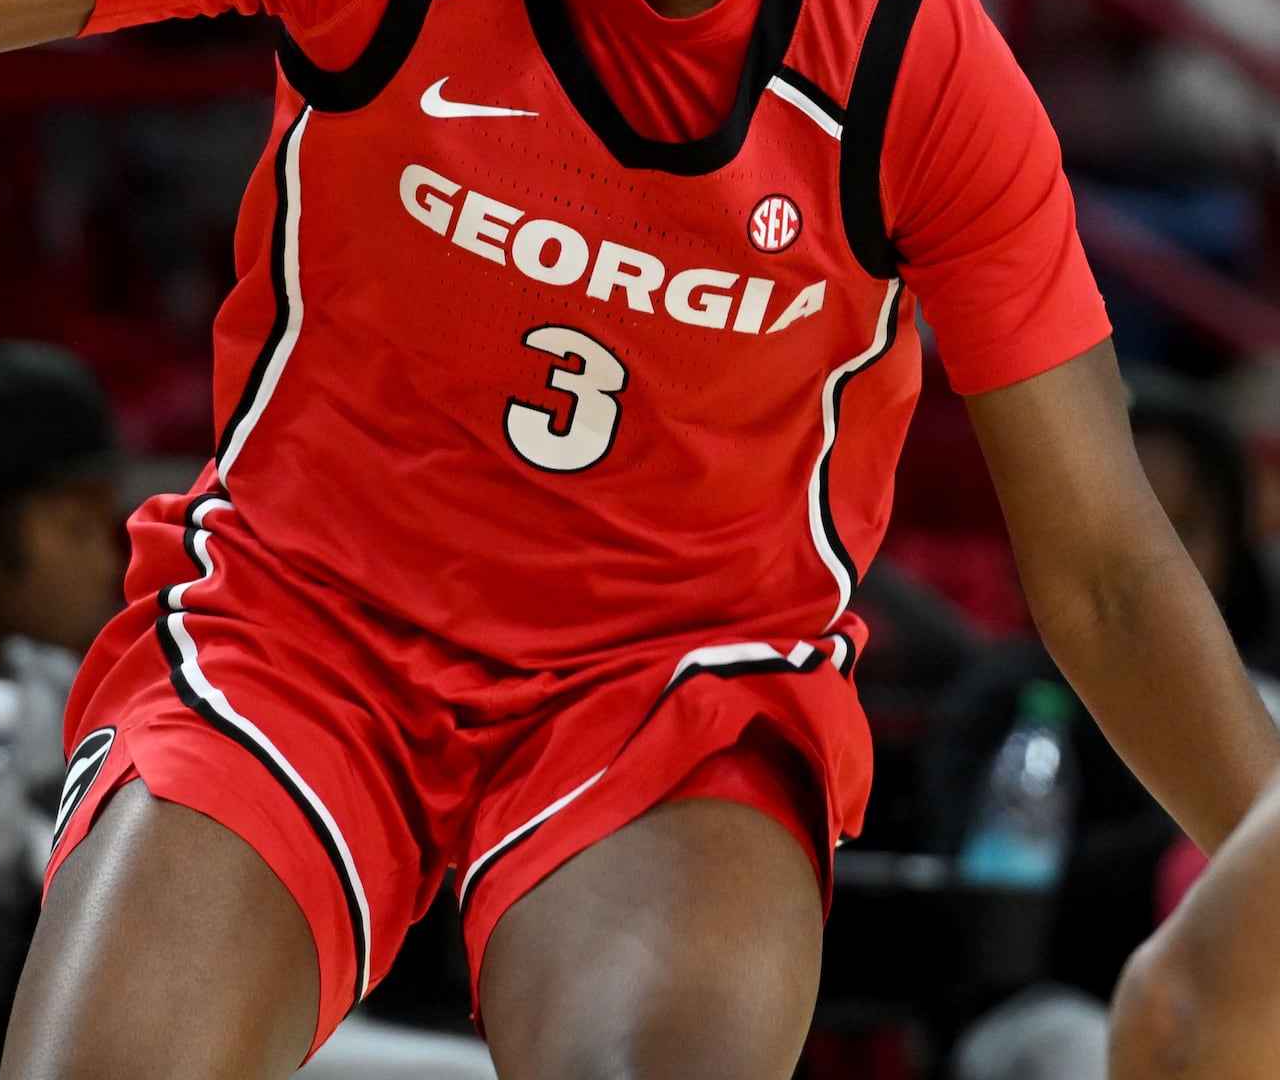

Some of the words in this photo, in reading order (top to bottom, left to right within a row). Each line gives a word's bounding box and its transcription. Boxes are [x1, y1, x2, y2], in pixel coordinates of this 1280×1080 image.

[398, 163, 827, 335] GEORGIA
[751, 197, 799, 250] SEC
[503, 324, 629, 473] 3
